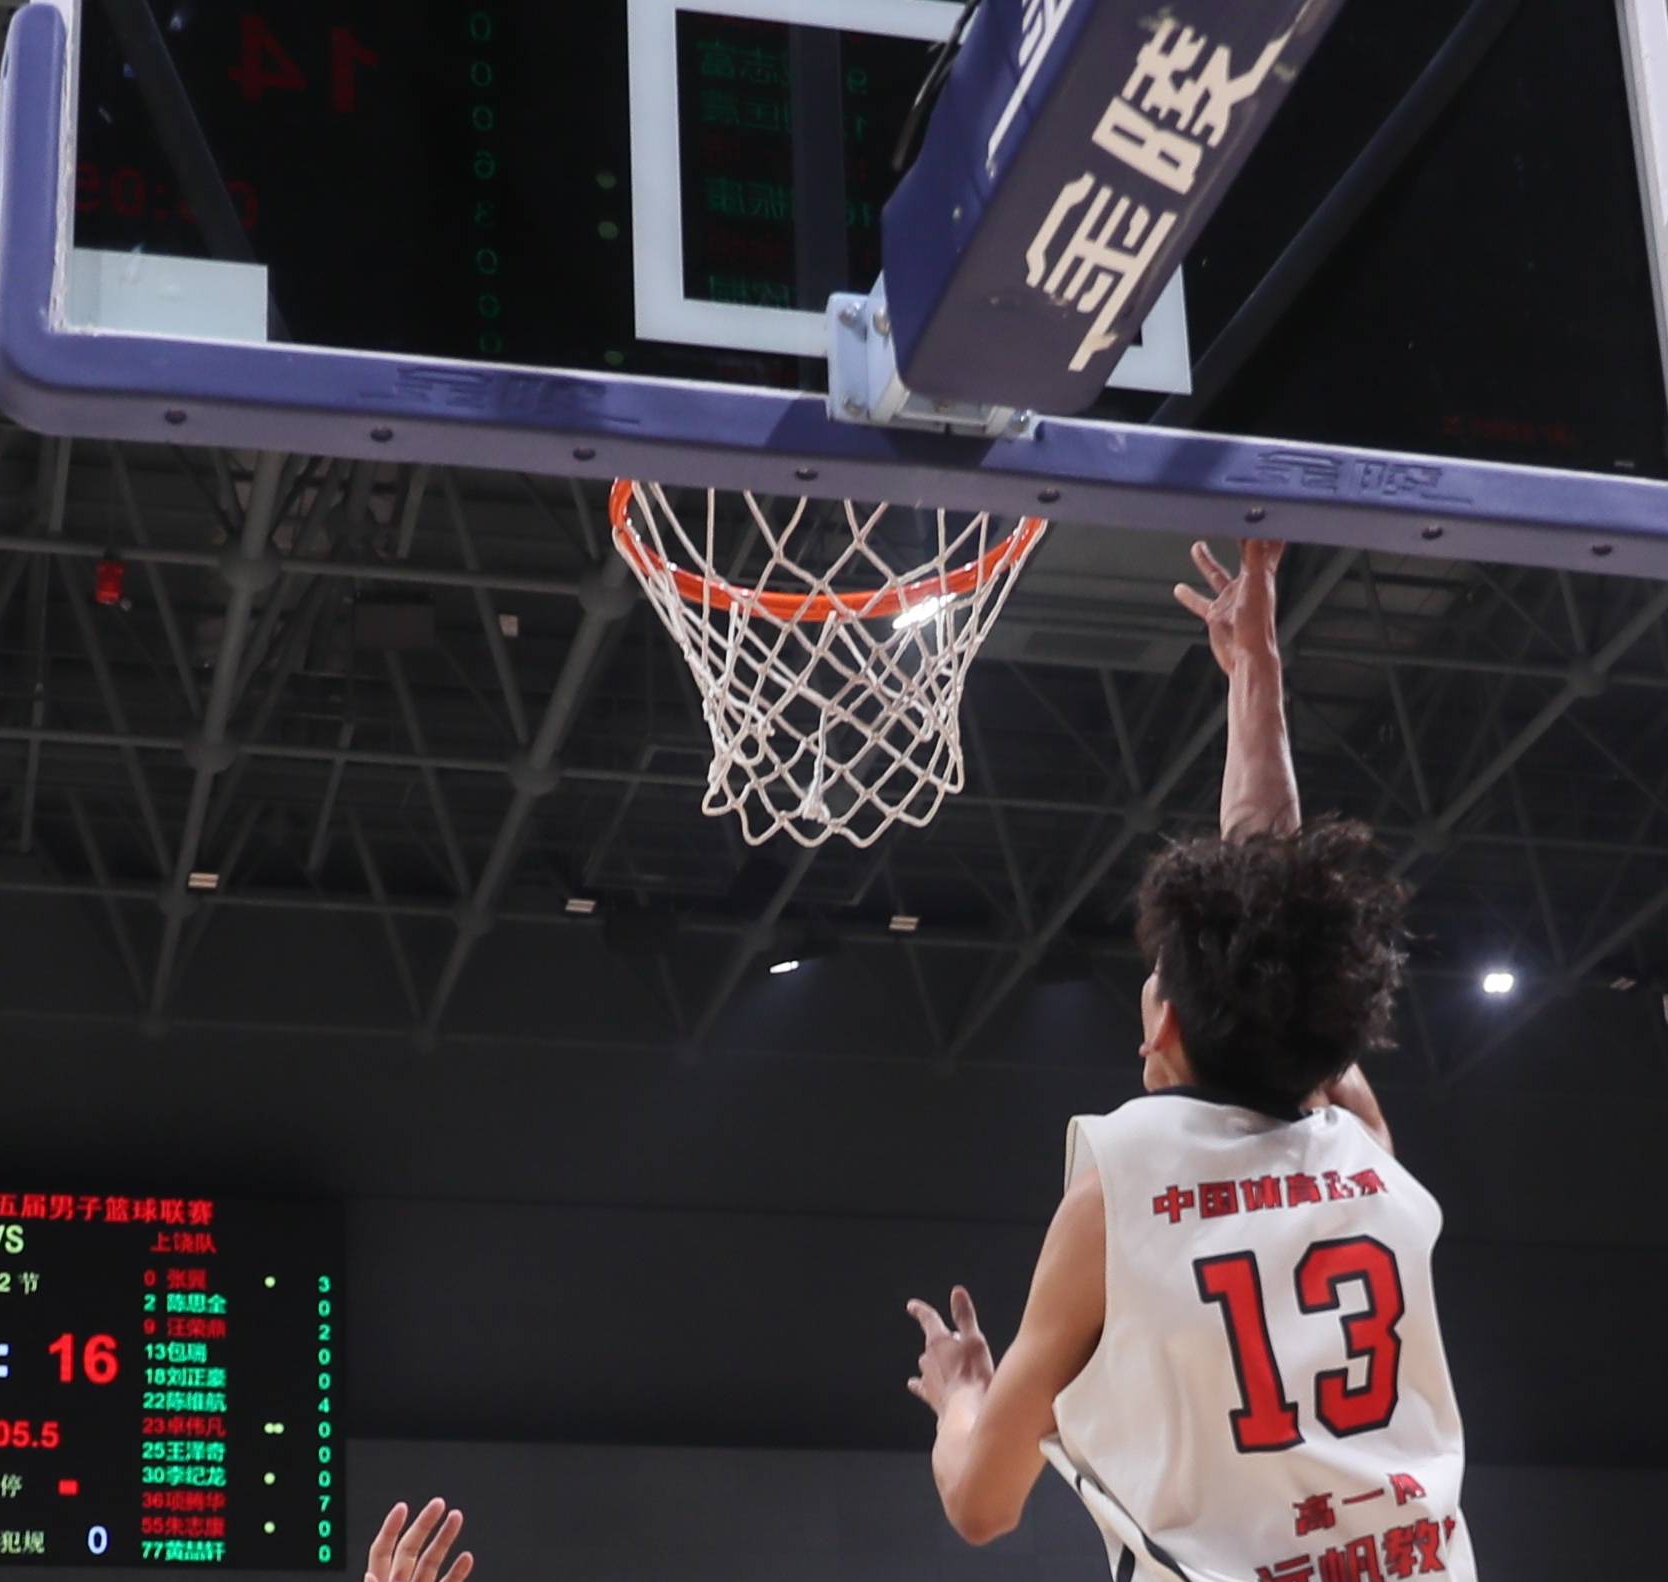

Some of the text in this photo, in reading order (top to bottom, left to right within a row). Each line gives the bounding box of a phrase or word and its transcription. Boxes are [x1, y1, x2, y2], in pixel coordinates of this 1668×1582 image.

[1026, 10, 1304, 372] 金陵
[318, 1275, 331, 1293] 3
[143, 1294, 157, 1312] 2
[318, 1300, 331, 1318] 0
[318, 1324, 331, 1342] 2
[1192, 1234, 1405, 1454] 13
[48, 1333, 120, 1384] 16
[318, 1348, 331, 1366] 0
[318, 1372, 331, 1390] 0
[318, 1397, 331, 1415] 4
[318, 1421, 331, 1439] 0
[318, 1446, 331, 1464] 0
[318, 1470, 331, 1488] 0
[318, 1495, 331, 1513] 7
[318, 1520, 331, 1538] 0
[88, 1525, 108, 1555] 0
[318, 1545, 331, 1563] 0
